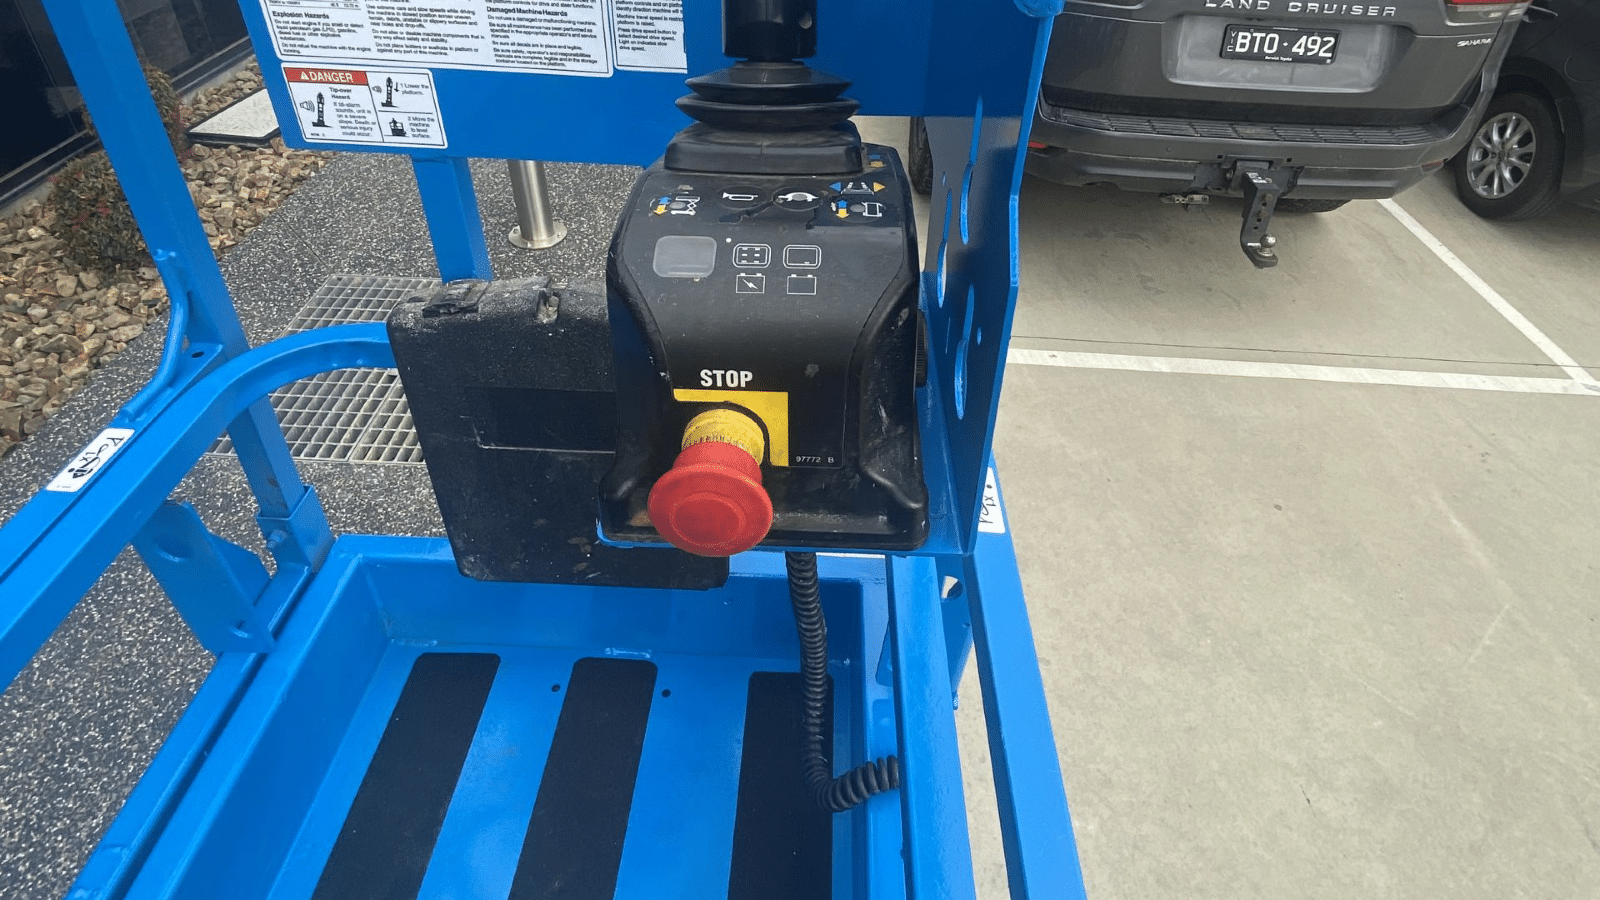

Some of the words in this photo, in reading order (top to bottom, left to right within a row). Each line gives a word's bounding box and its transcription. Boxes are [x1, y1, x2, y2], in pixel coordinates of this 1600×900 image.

[486, 6, 517, 15] Damaged
[1205, 0, 1270, 10] LAND
[1287, 2, 1397, 17] CRUISER
[272, 10, 304, 20] Explosion
[1235, 32, 1279, 54] BTO
[1292, 35, 1335, 58] 492
[1457, 38, 1492, 47] SAHARA
[309, 72, 354, 82] DANGER
[700, 369, 753, 388] STOP
